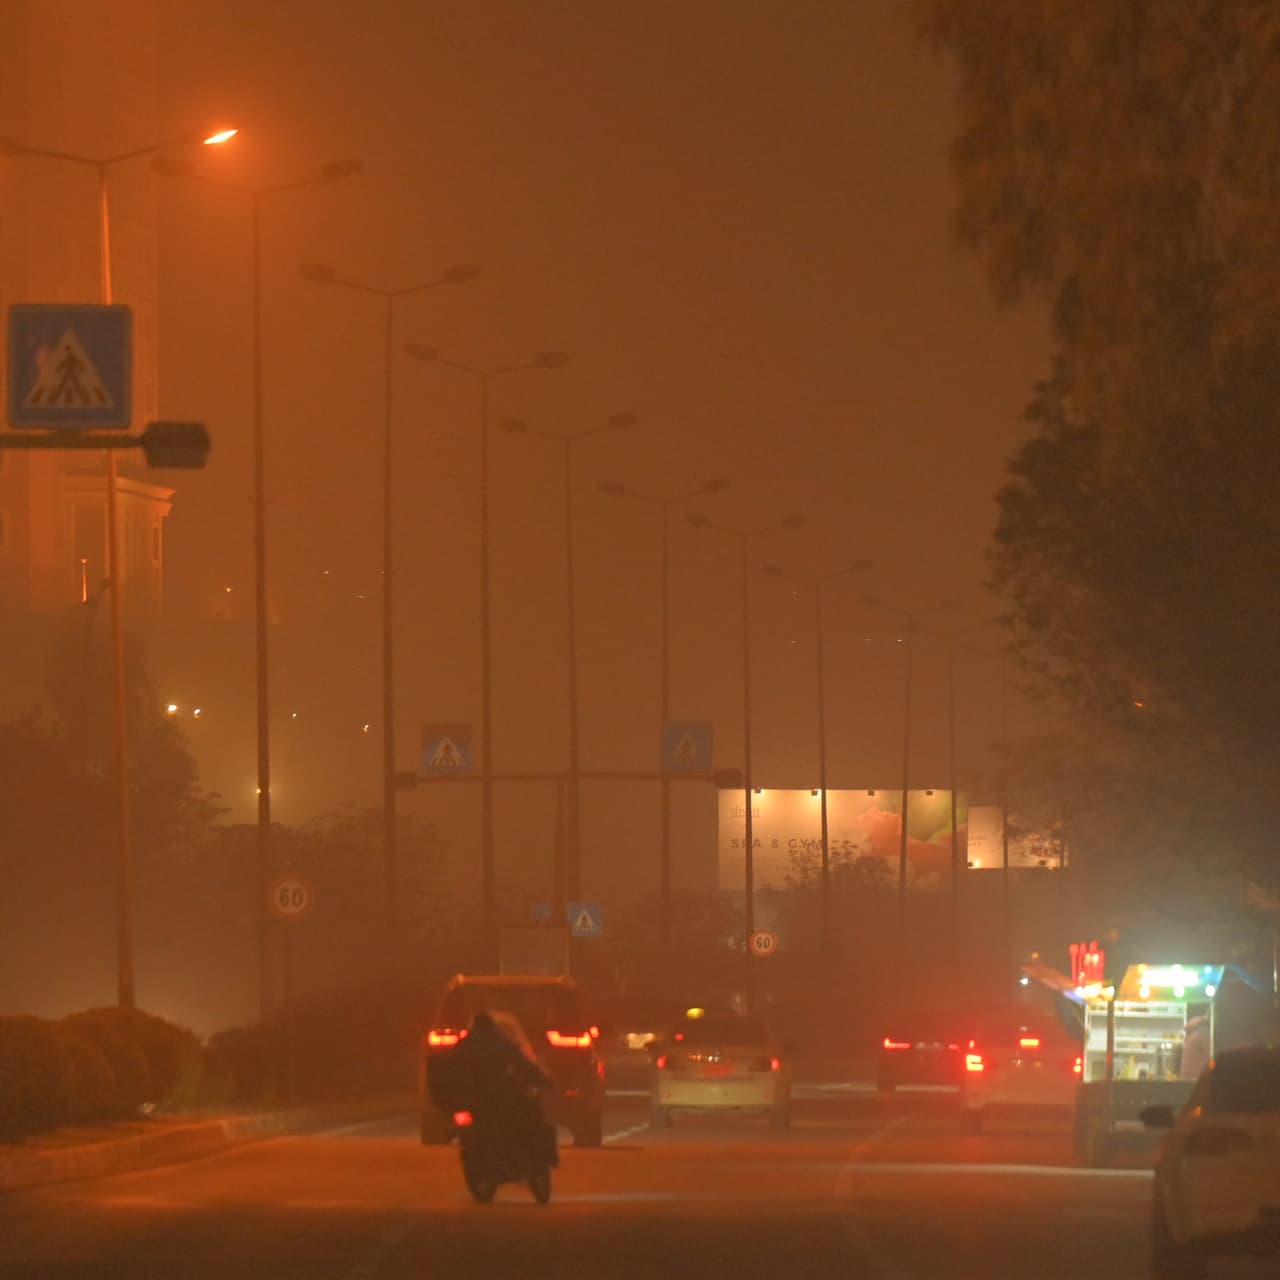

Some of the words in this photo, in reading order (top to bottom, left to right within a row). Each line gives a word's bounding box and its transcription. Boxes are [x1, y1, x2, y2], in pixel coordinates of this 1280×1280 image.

[771, 838, 780, 849] &
[280, 888, 302, 907] 60
[756, 937, 770, 949] 60
